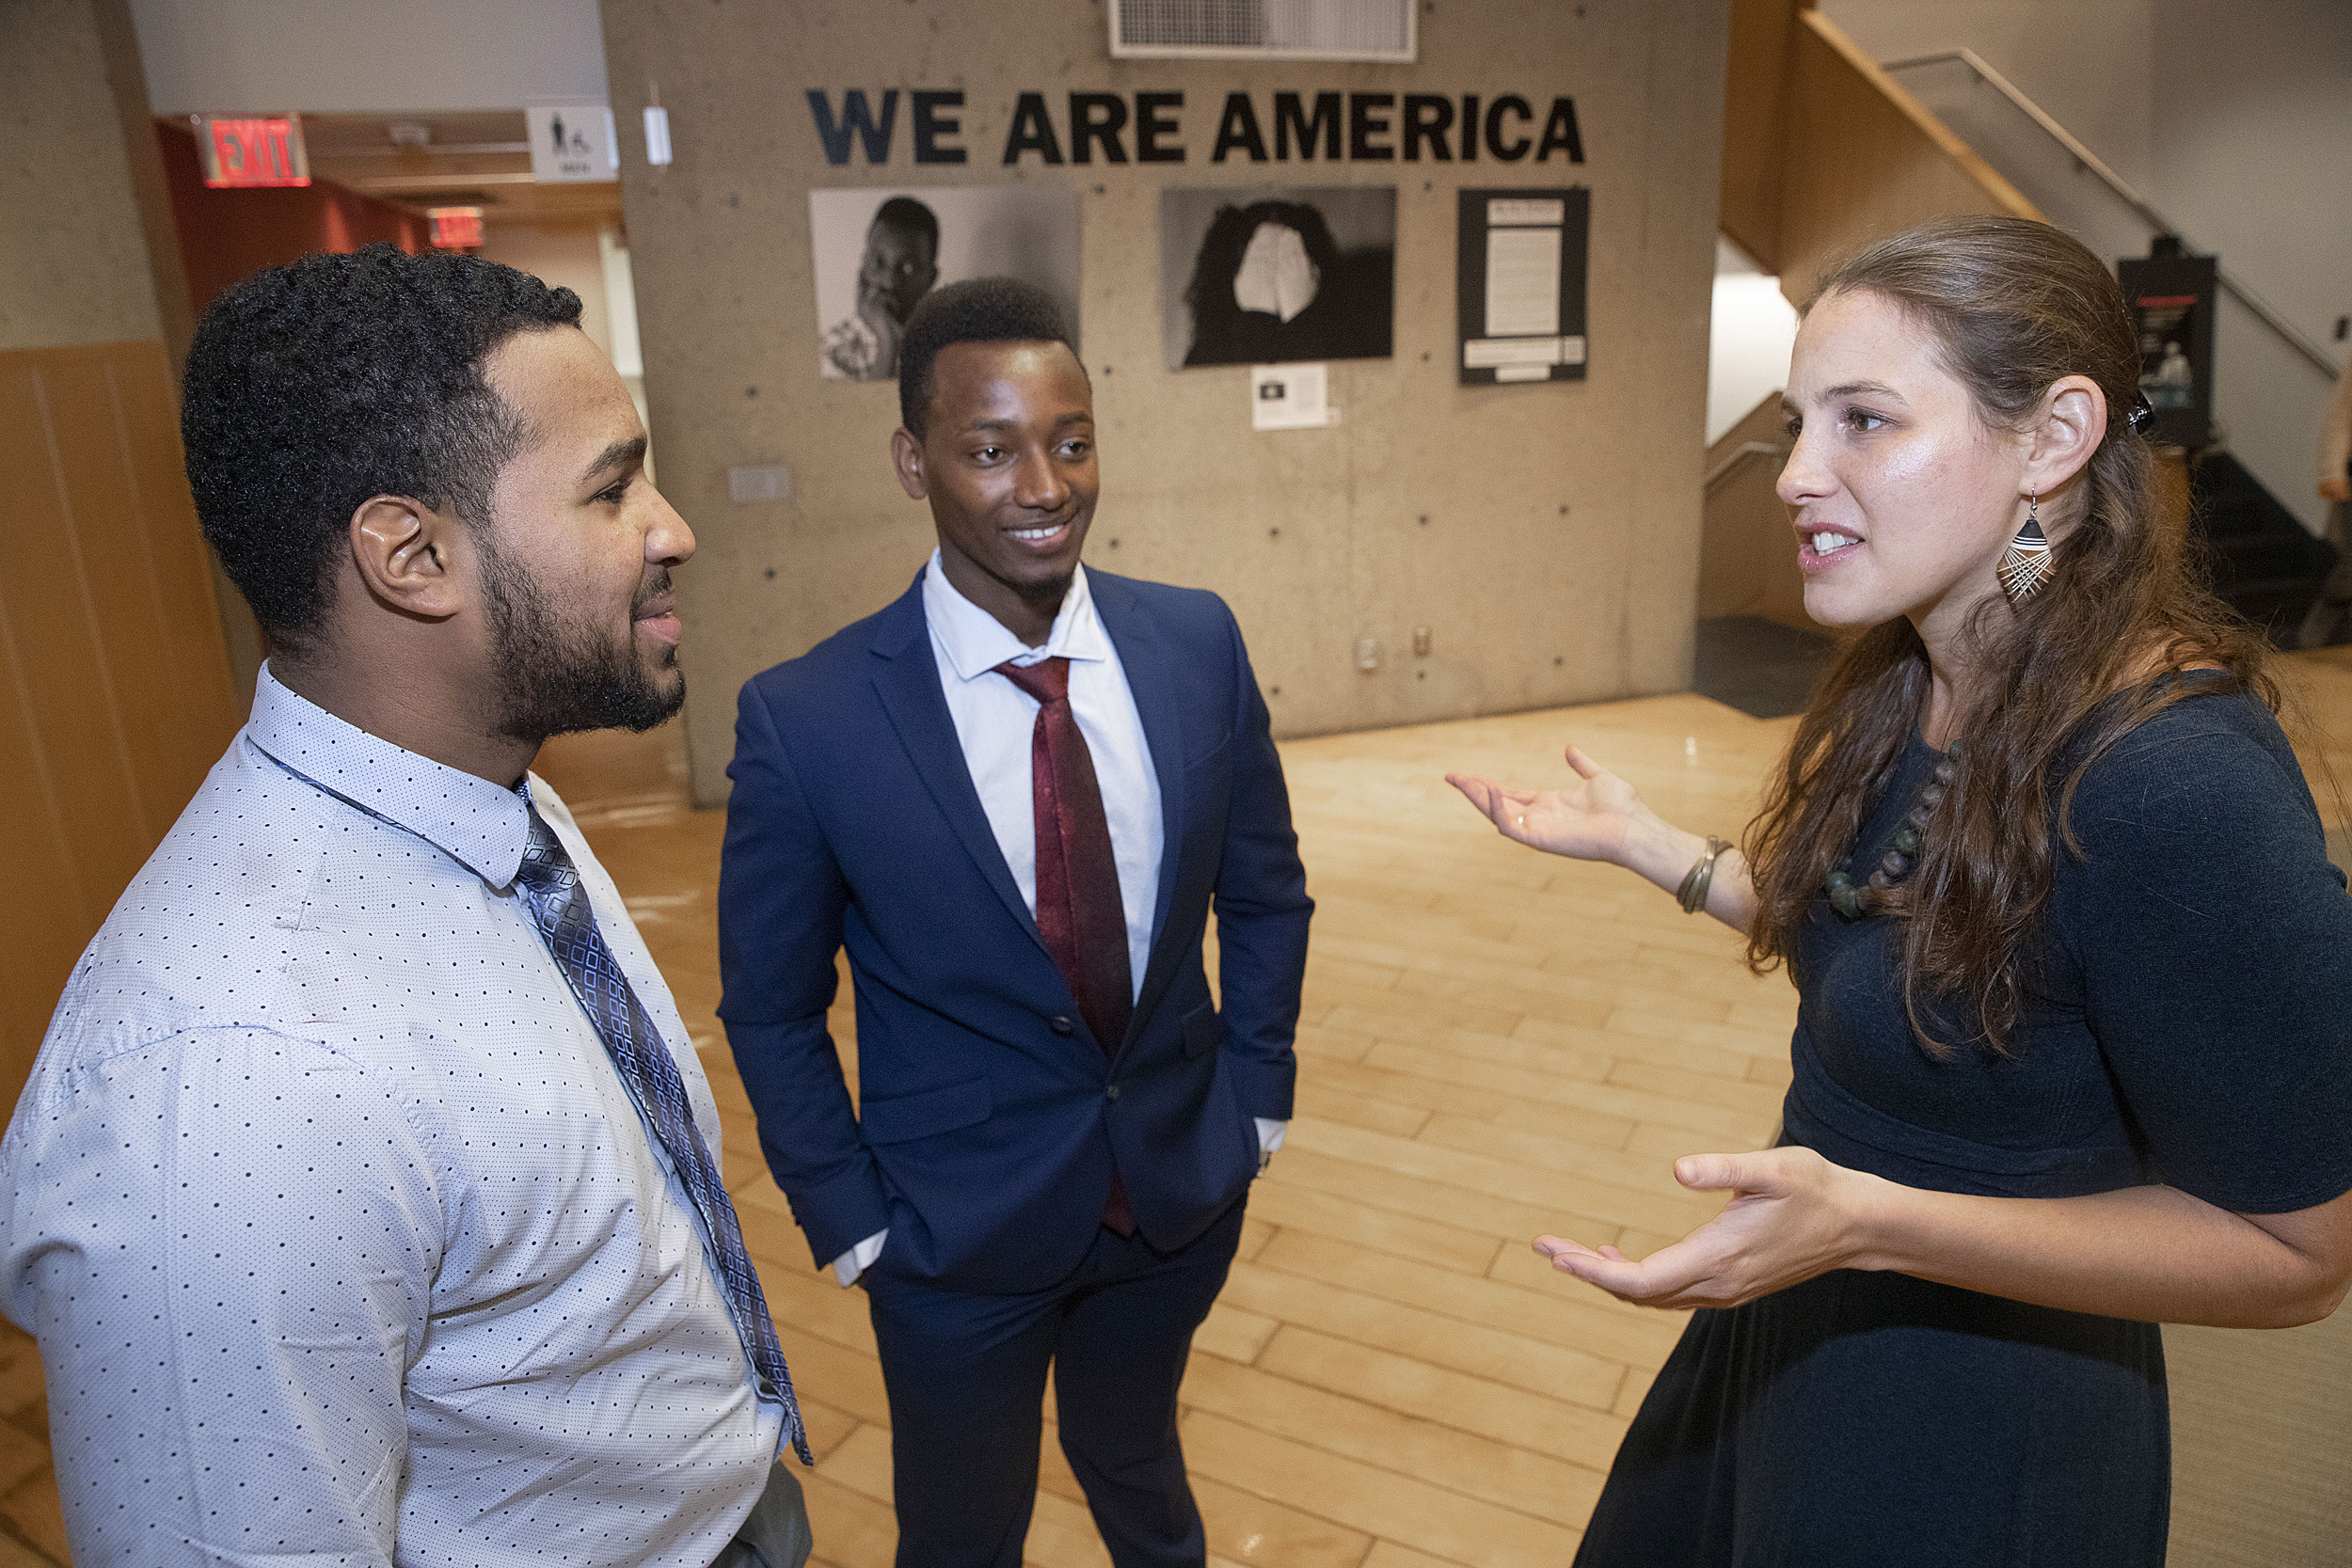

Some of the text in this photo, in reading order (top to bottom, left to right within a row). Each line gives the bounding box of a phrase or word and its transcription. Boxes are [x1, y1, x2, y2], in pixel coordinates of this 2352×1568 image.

[211, 119, 293, 181] EXIT
[806, 88, 1585, 166] WE ARE AMERICA
